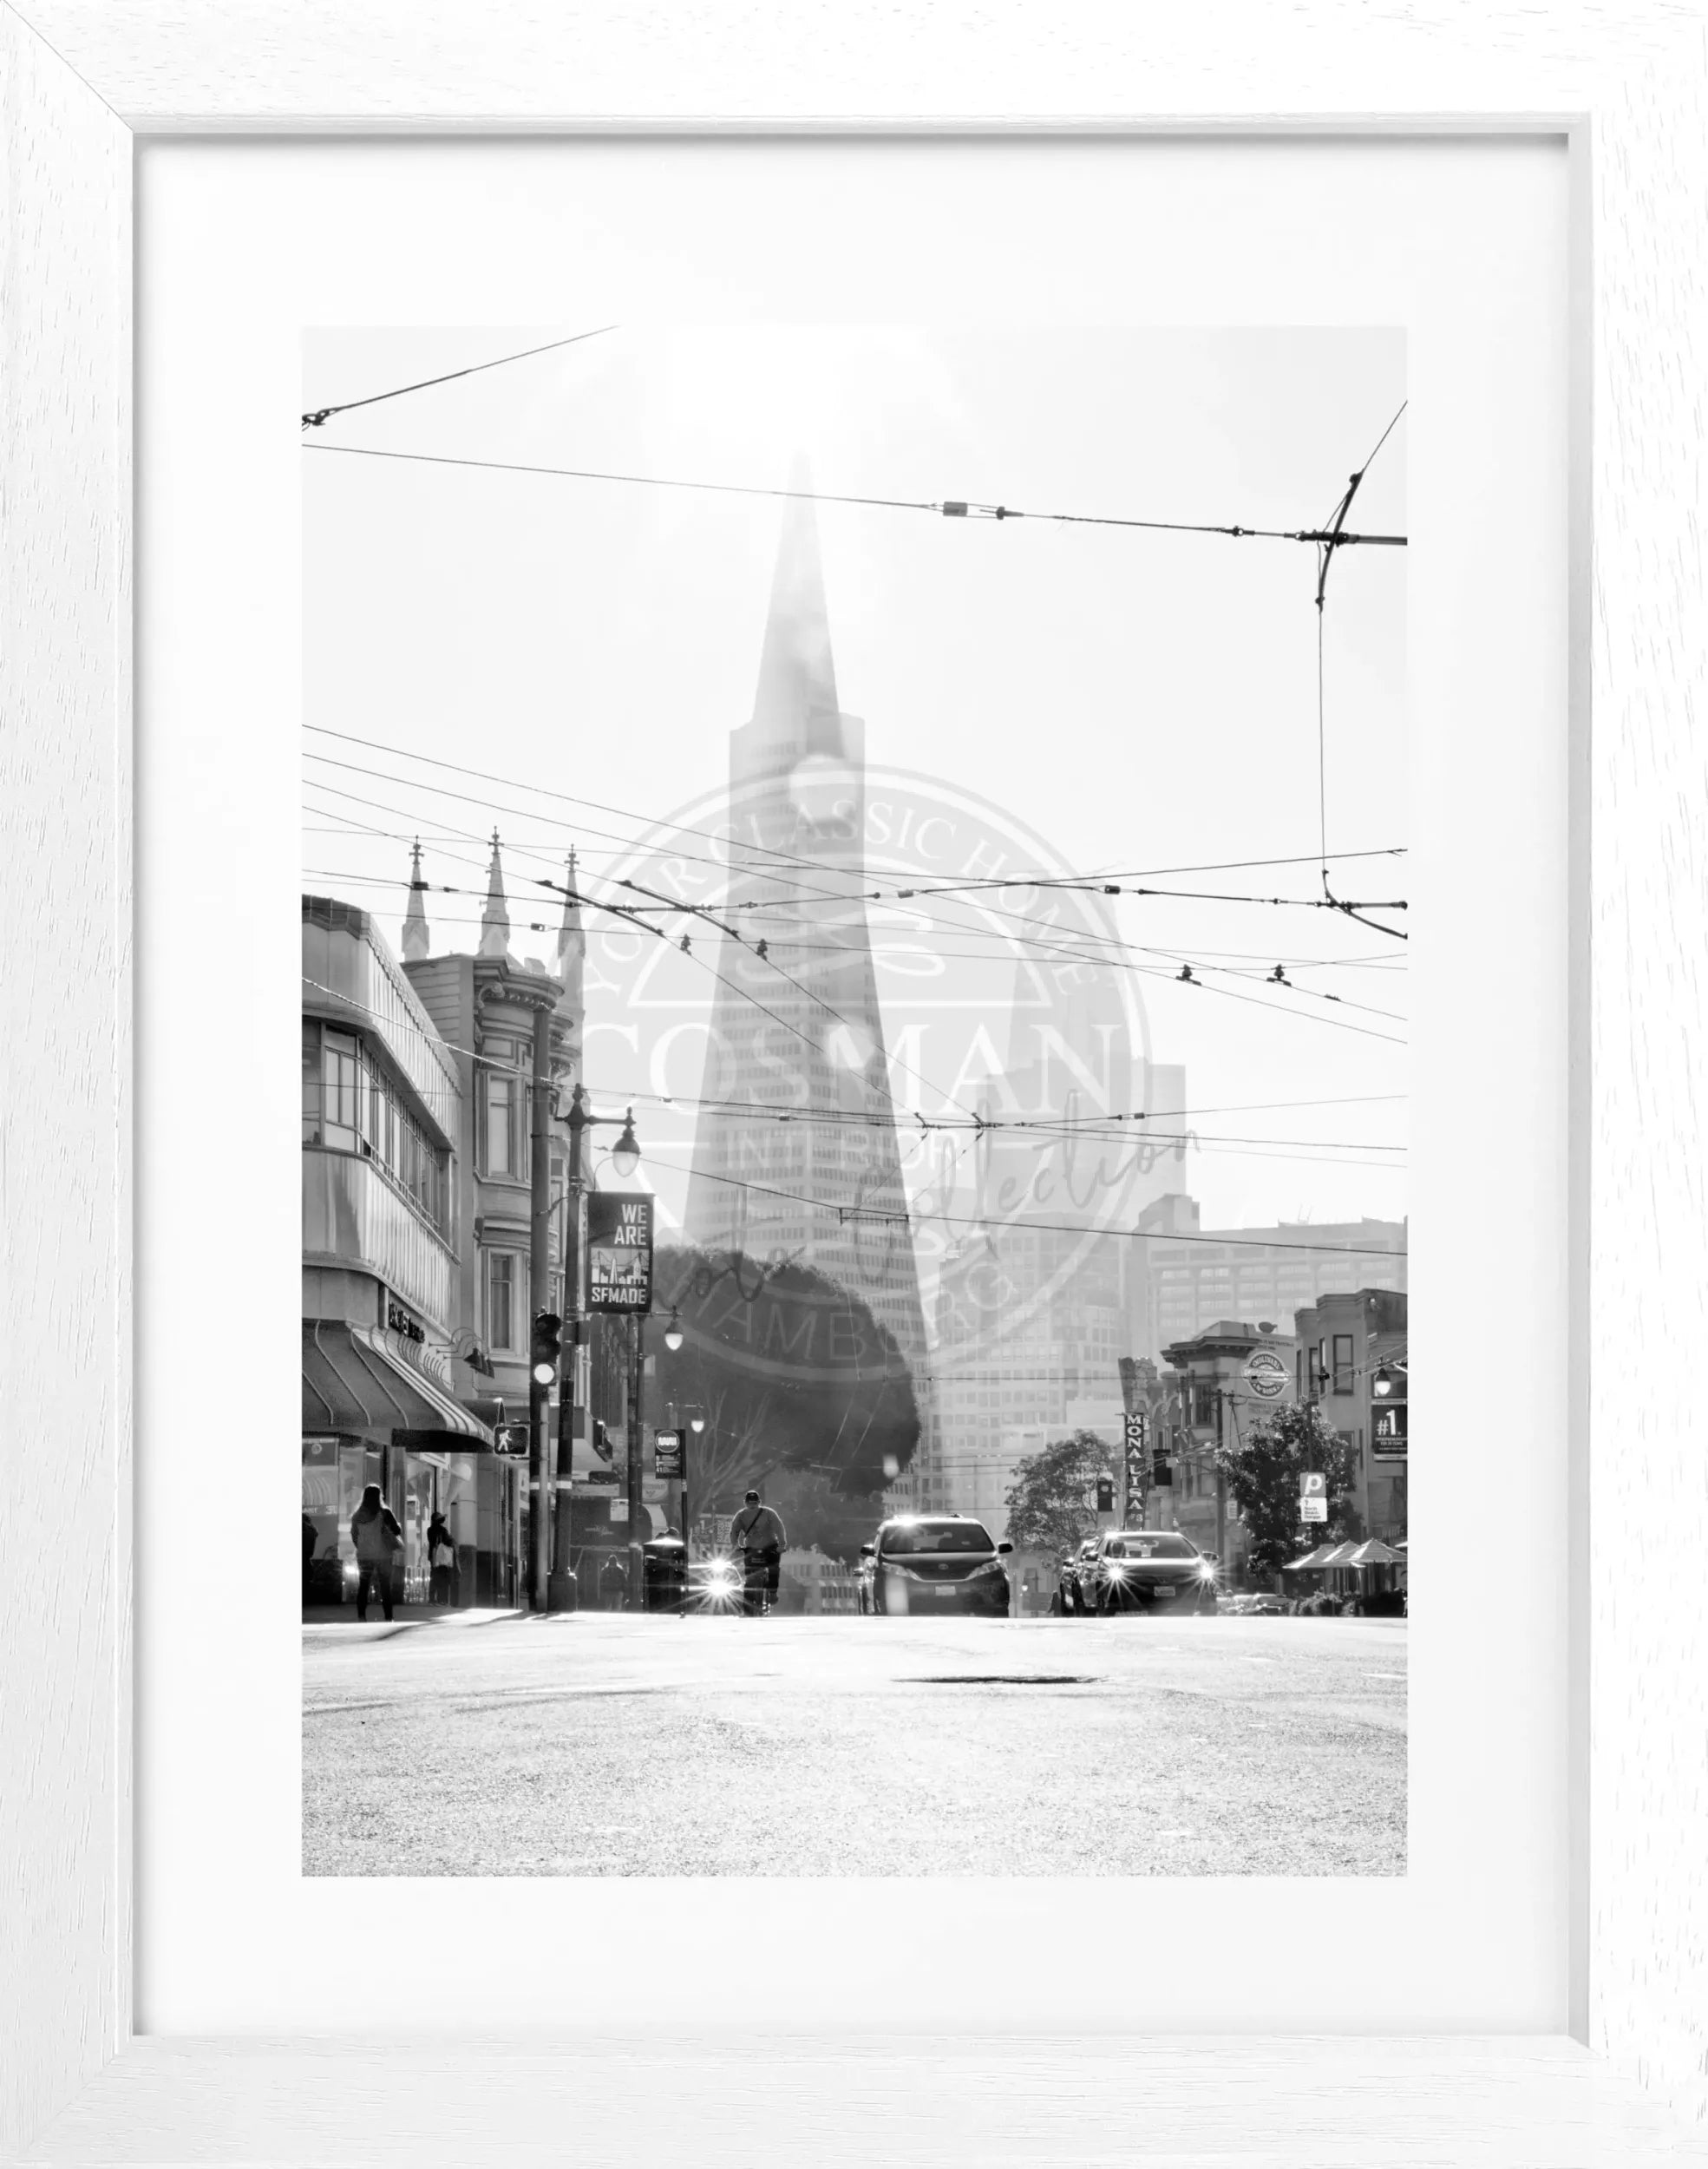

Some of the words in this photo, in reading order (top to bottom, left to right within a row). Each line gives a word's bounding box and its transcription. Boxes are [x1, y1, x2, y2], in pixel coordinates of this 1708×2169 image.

[622, 1204, 647, 1223] WE
[614, 1225, 647, 1245] ARE
[592, 1287, 646, 1304] SFMADE
[1128, 1414, 1142, 1458] MONA
[1128, 1465, 1143, 1510] LISA
[1304, 1475, 1322, 1495] P
